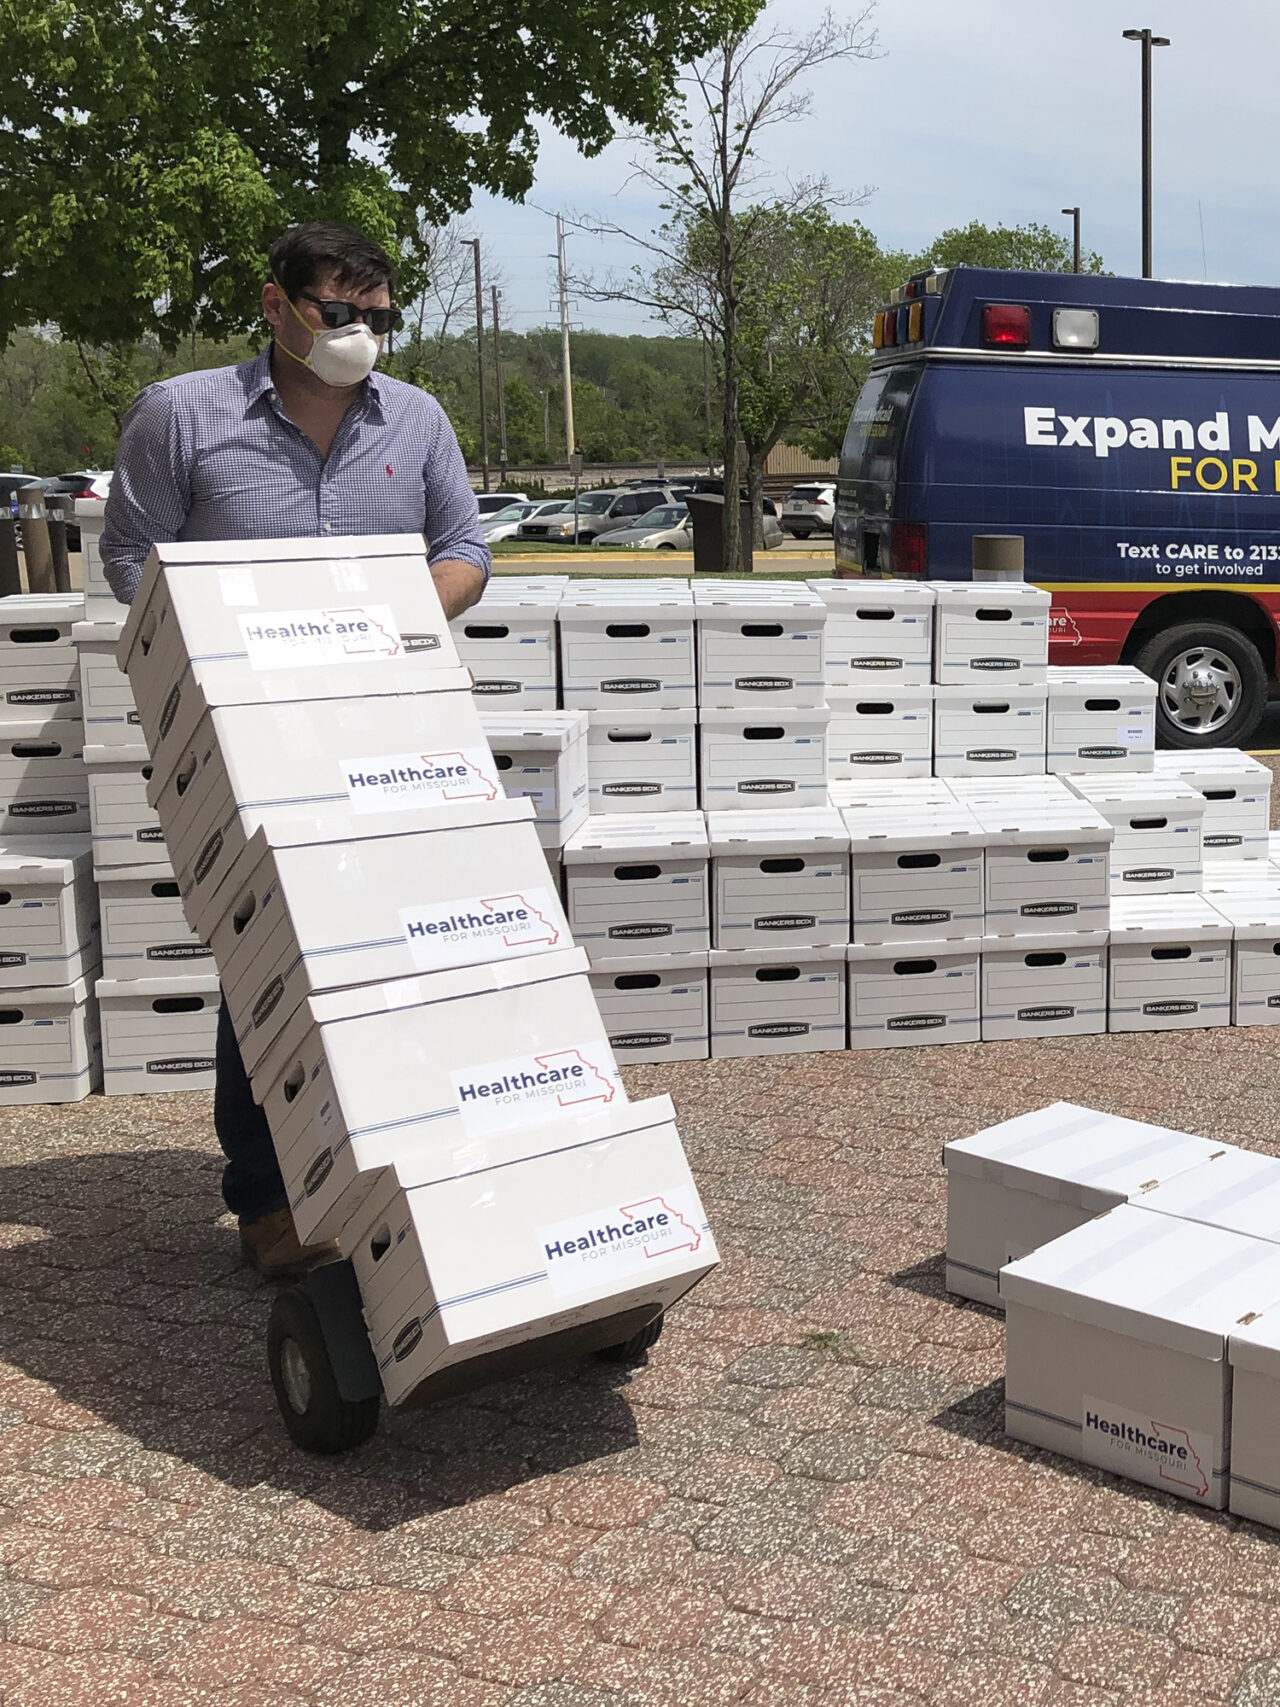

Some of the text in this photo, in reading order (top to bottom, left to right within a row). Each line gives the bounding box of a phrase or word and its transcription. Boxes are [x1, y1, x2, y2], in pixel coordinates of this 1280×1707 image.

[1024, 407, 1230, 457] Expand
[1170, 456, 1259, 491] FOR
[1117, 543, 1159, 559] Text
[1165, 544, 1218, 560] CARE
[1224, 546, 1244, 560] to
[1156, 562, 1263, 577] to get involved
[412, 637, 436, 646] BOX
[11, 692, 71, 701] BANKERS BOX
[348, 765, 468, 788] Healthcare
[54, 804, 73, 812] BOX
[894, 912, 948, 922] BANKERS BOX
[407, 908, 529, 938] Healthcare
[758, 919, 795, 927] BANKERS
[612, 926, 669, 936] BANKERS BOX
[2, 955, 23, 963] BOX
[890, 1019, 926, 1027] BANKERS
[789, 1025, 806, 1033] BOX
[611, 1035, 668, 1045] BANKERS BOX
[151, 1060, 213, 1070] BANKERS BOX
[459, 1064, 584, 1102] Healthcare
[544, 1213, 669, 1260] Healthcare
[1086, 1411, 1188, 1460] Healthcare
